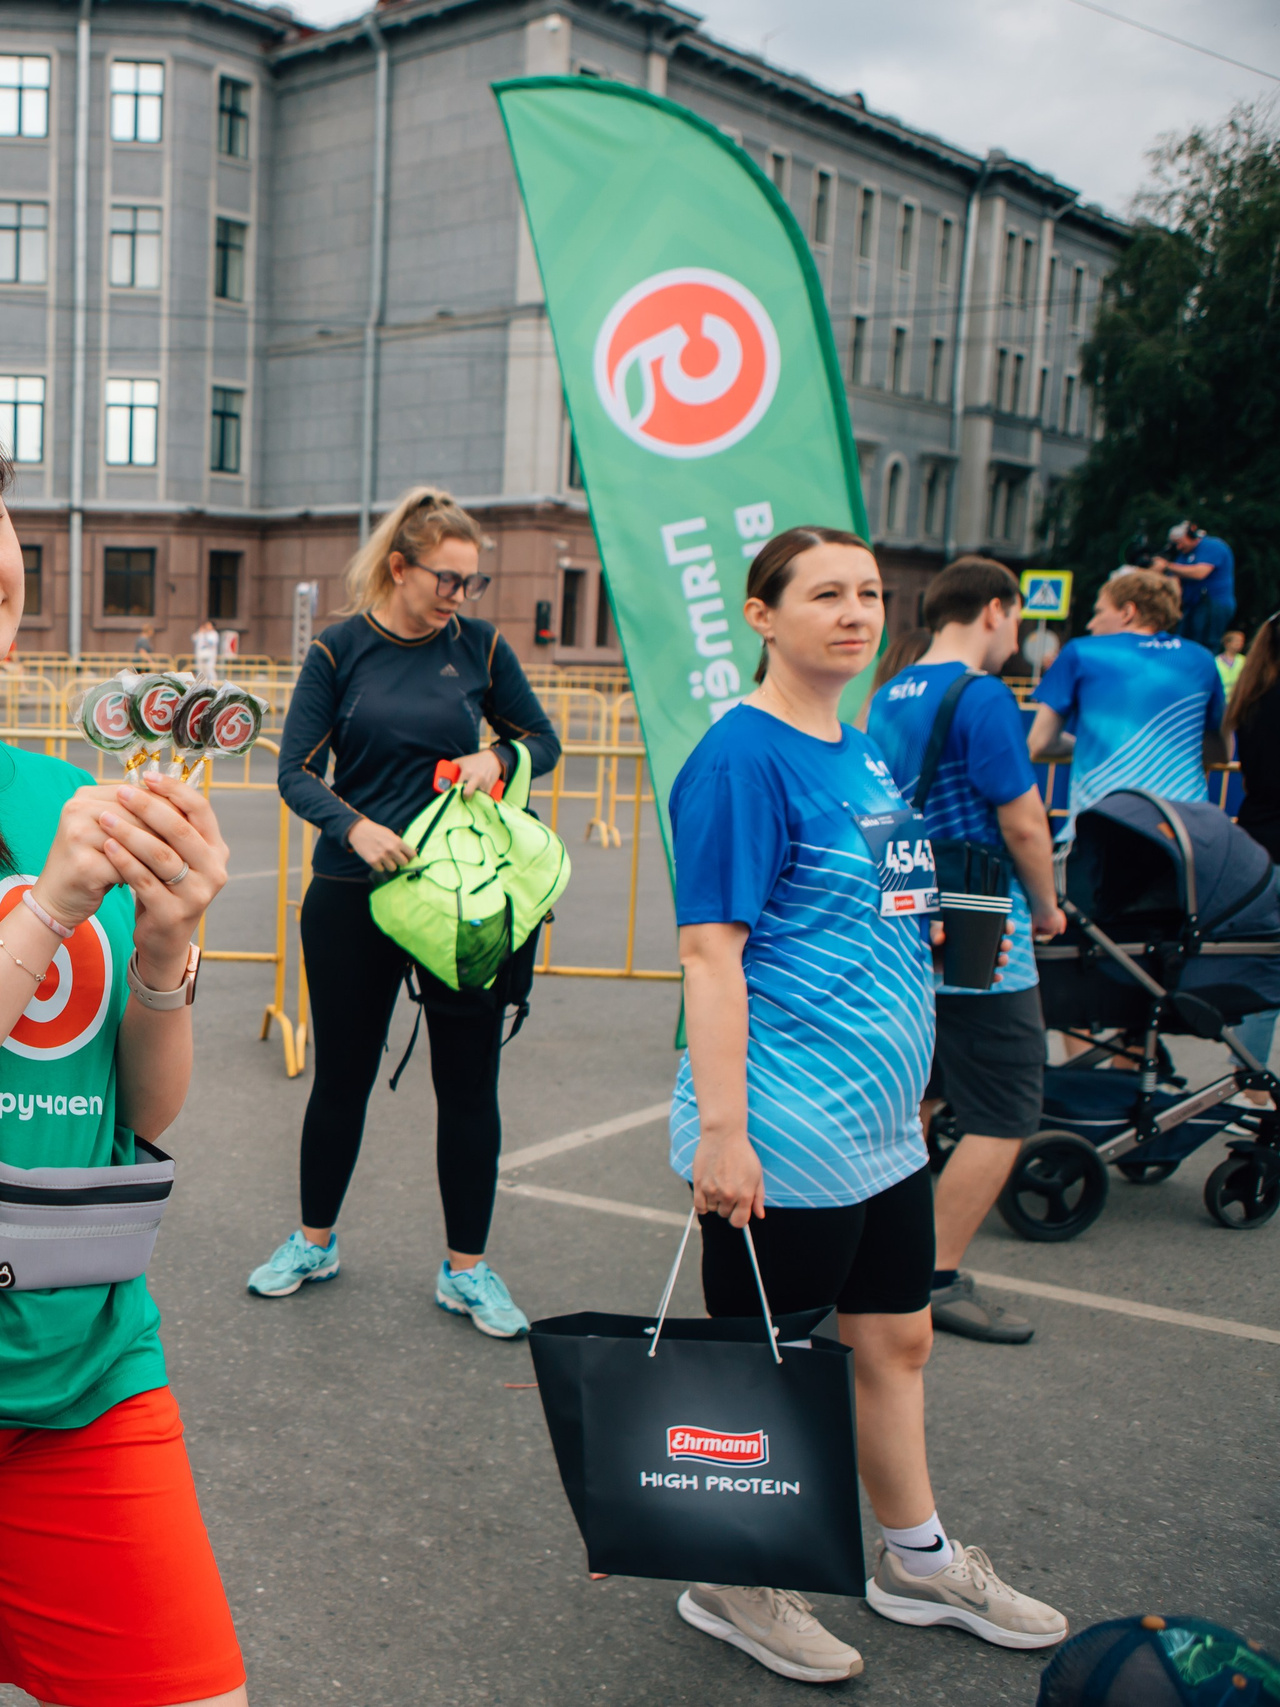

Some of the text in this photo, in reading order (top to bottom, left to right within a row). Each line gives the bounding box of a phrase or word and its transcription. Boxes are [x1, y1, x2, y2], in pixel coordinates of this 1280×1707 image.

[671, 1431, 760, 1455] Ehrmann
[640, 1471, 801, 1496] HIGH PROTEIN
